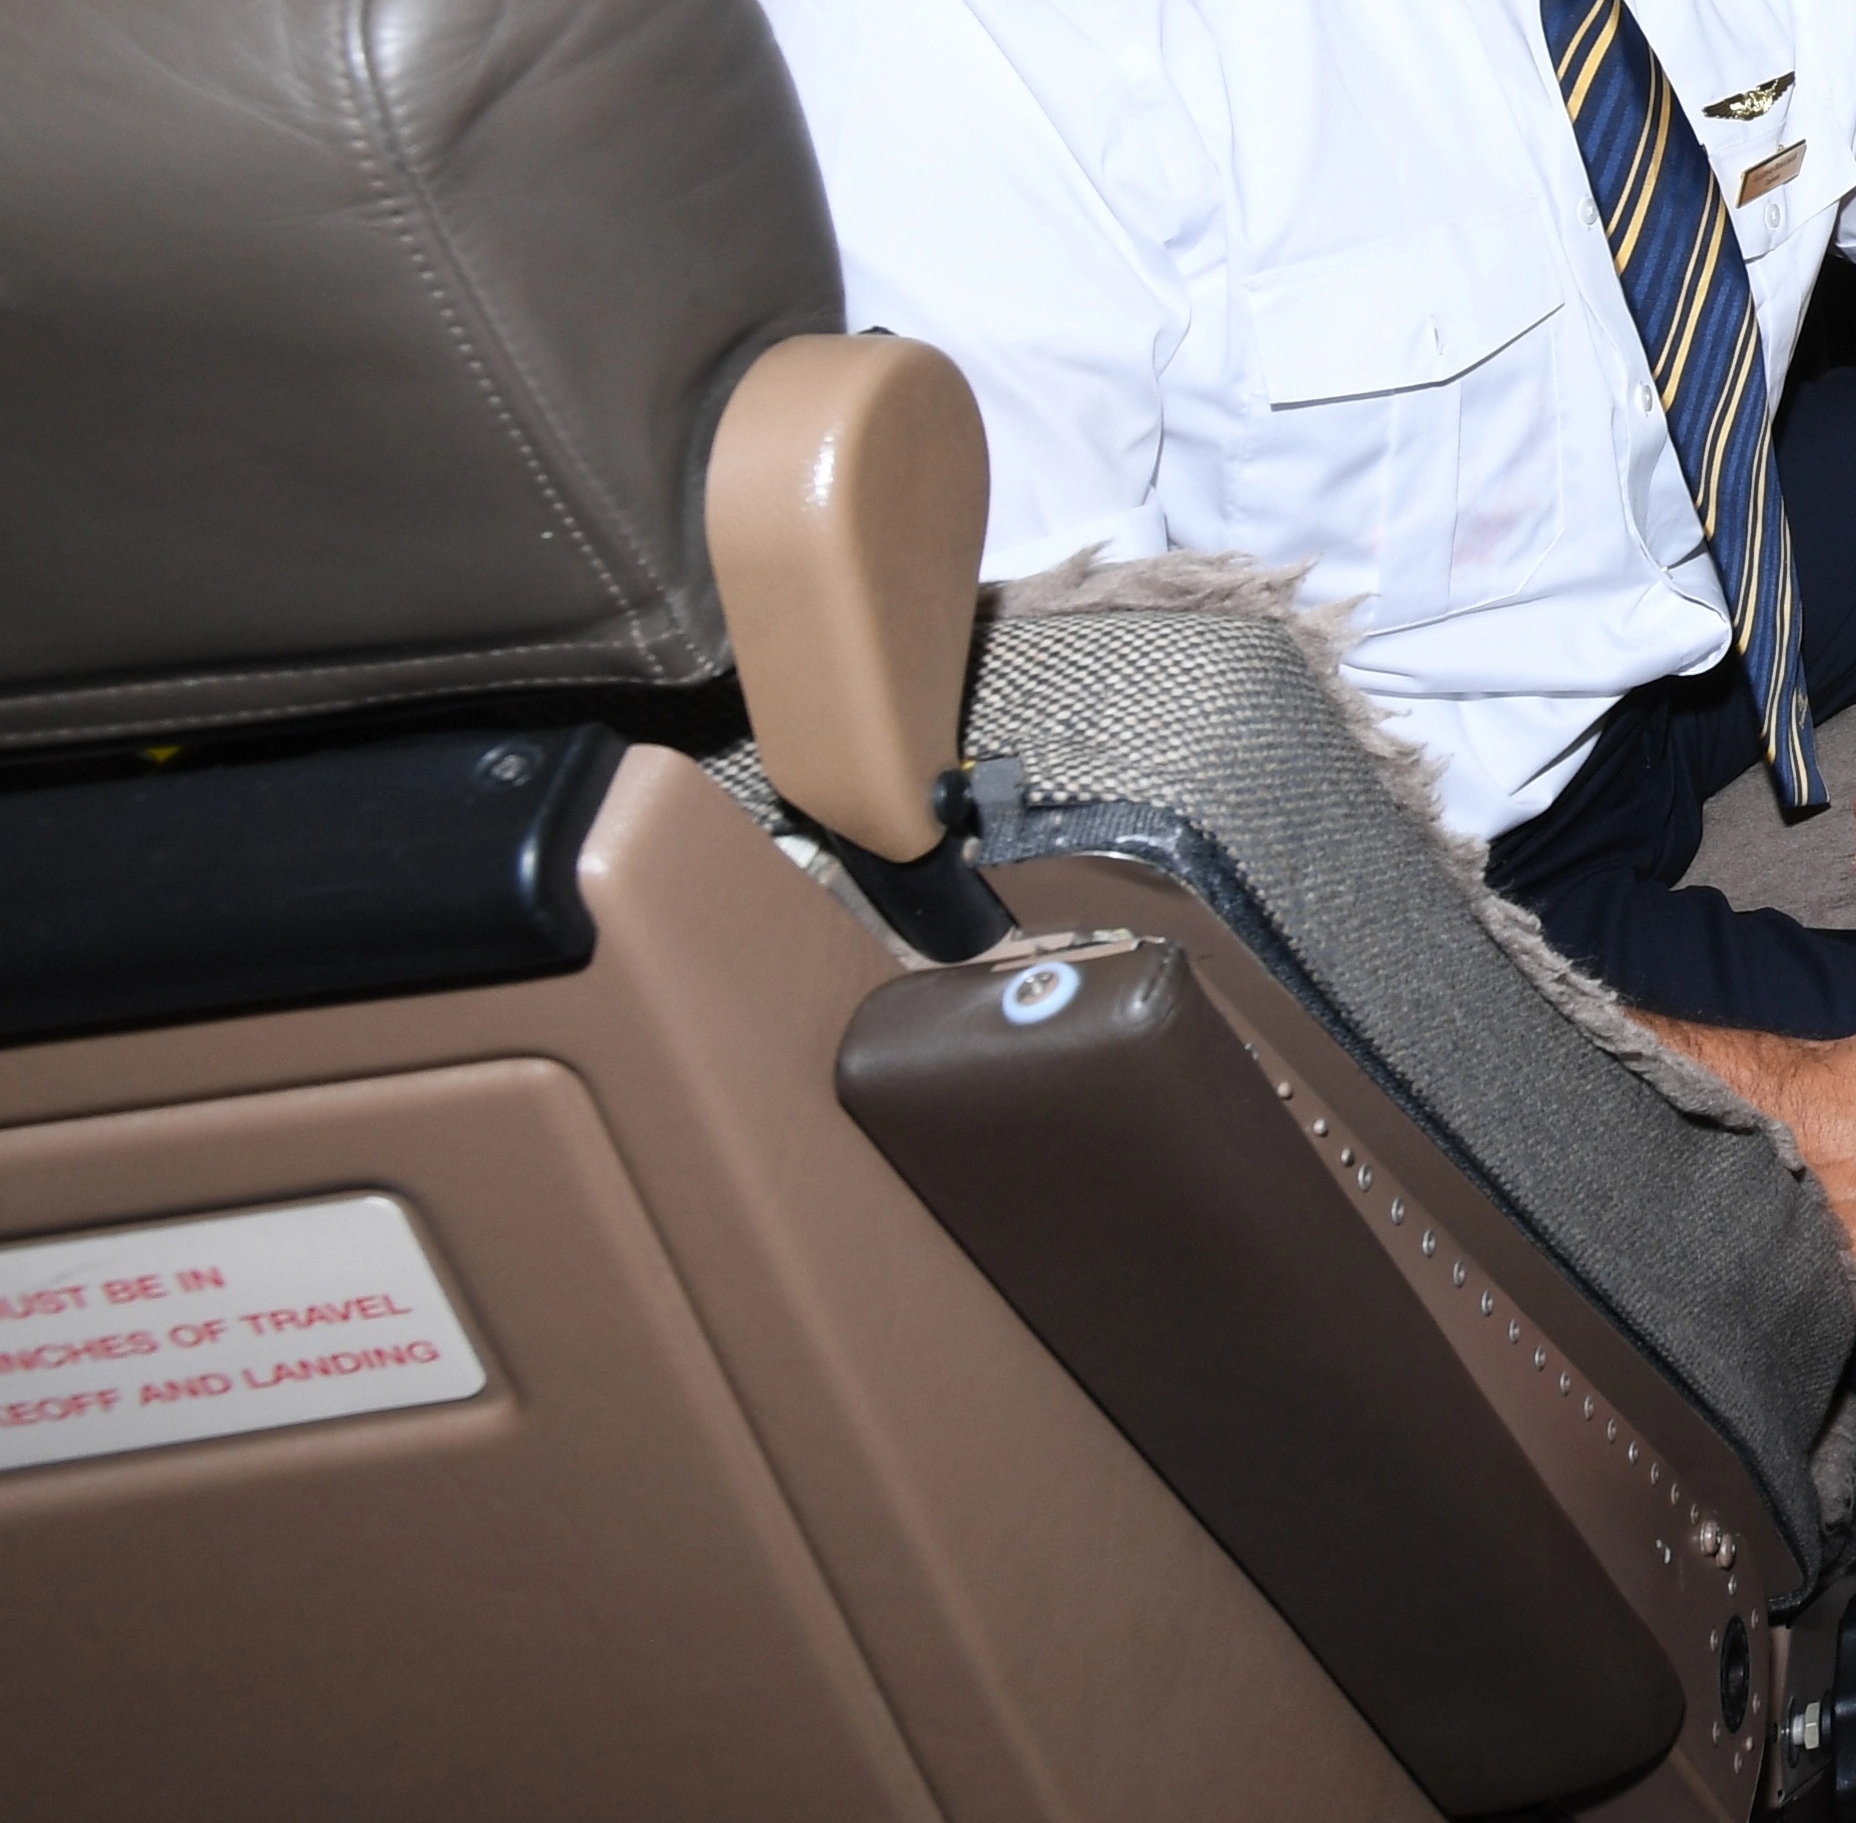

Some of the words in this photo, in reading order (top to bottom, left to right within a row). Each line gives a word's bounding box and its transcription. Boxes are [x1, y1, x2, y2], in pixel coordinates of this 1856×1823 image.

[0, 1284, 88, 1322] UST
[104, 1274, 168, 1306] BE
[177, 1266, 225, 1294] IN
[168, 1319, 228, 1349] OF
[239, 1294, 412, 1336] TRAVEL
[0, 1388, 122, 1429] EOFF
[139, 1372, 233, 1408] AND
[243, 1340, 441, 1390] LANDING
